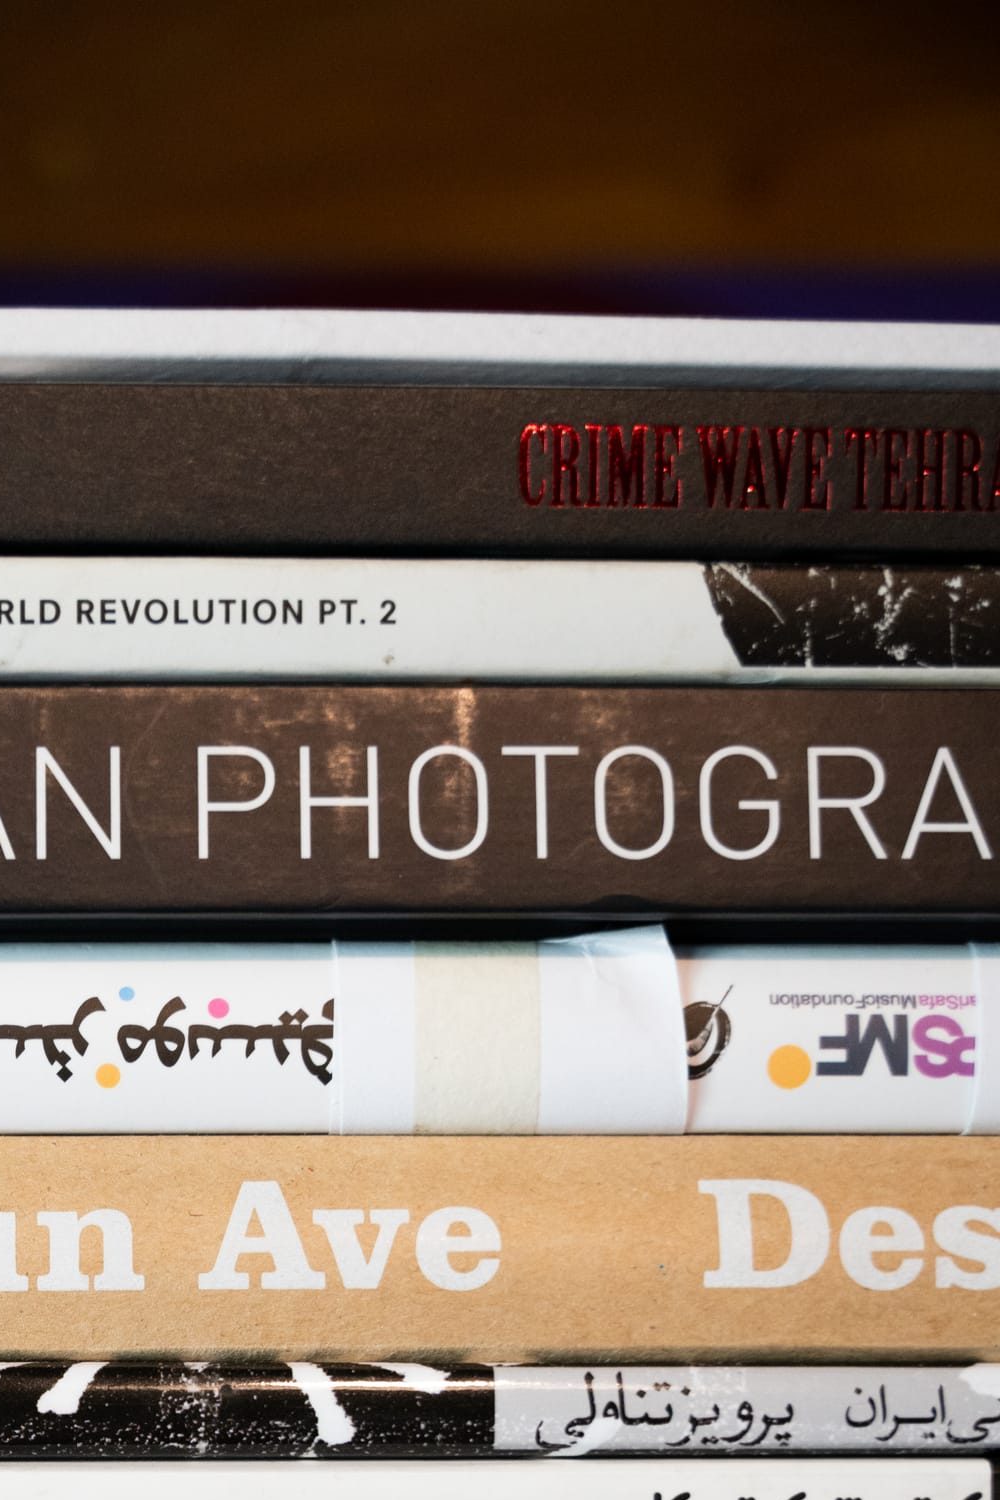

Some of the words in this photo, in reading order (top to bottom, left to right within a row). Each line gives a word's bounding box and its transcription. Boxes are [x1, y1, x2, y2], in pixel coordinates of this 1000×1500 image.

[518, 422, 683, 509] CRIME
[696, 425, 832, 511] WAVE
[76, 598, 305, 626] REVOLUTION
[318, 598, 367, 626] PT.
[377, 598, 398, 626] 2
[196, 744, 994, 861] PHOTOGRA
[117, 995, 334, 1086] موسیق
[198, 1179, 502, 1292] Ave
[697, 1178, 1000, 1292] Des
[664, 1385, 795, 1447] پرویز
[845, 1383, 946, 1442] ایران
